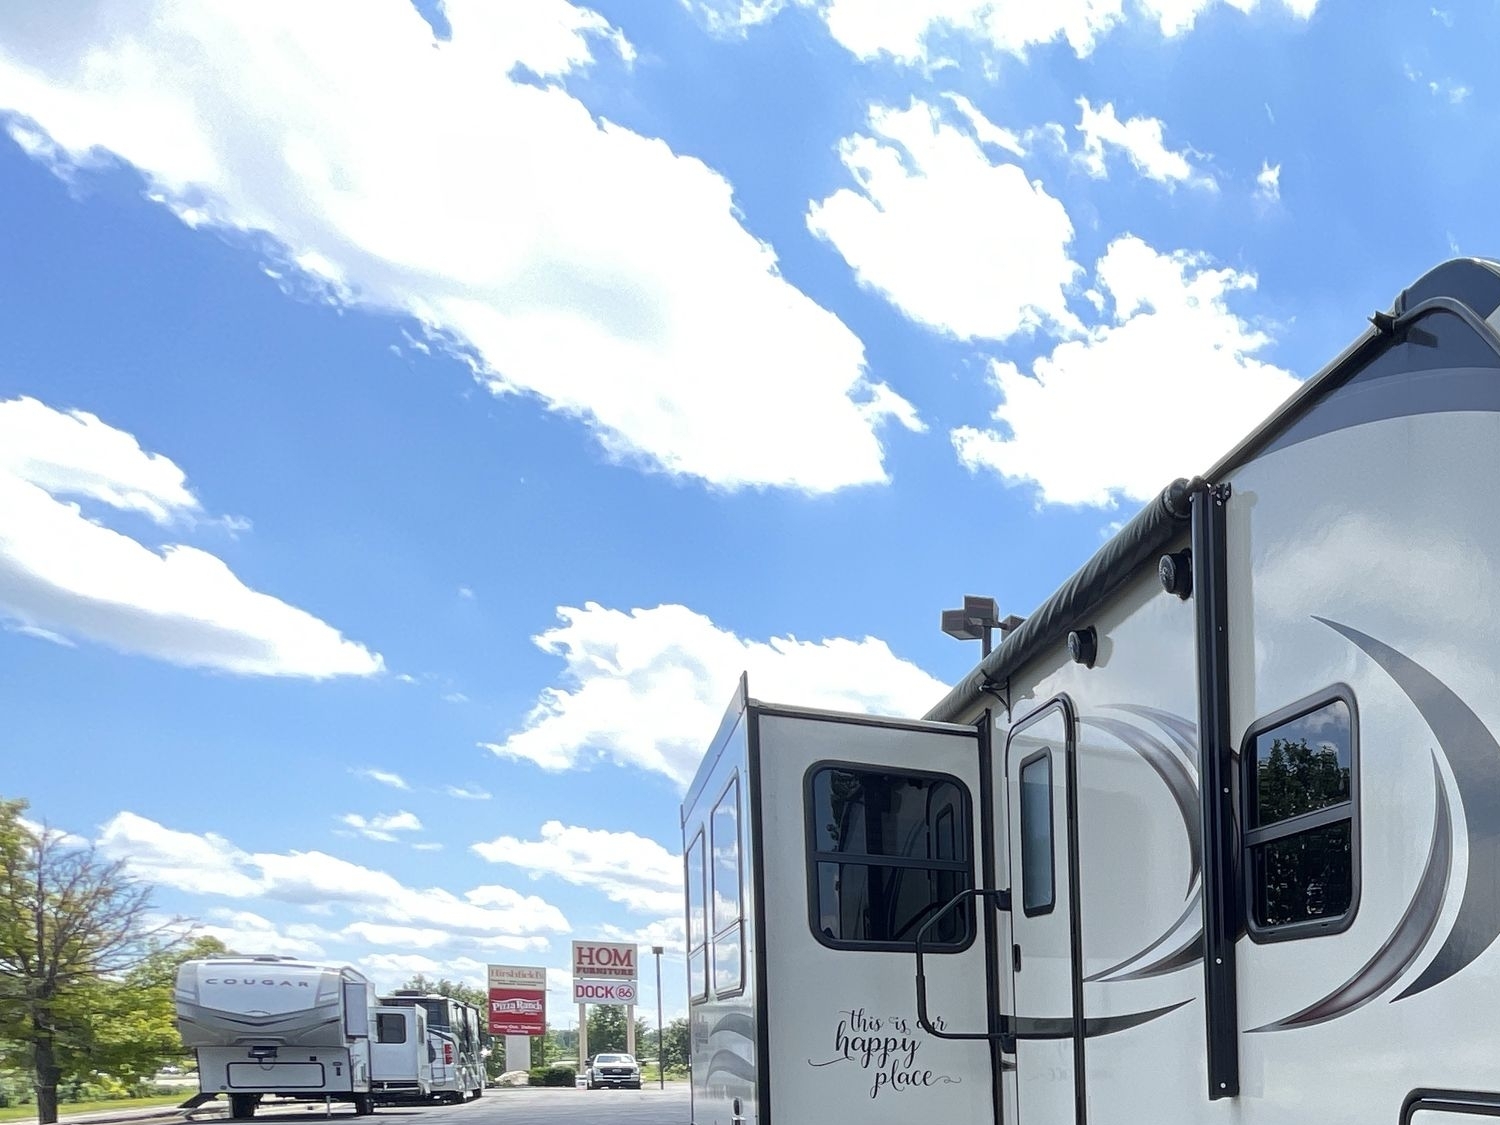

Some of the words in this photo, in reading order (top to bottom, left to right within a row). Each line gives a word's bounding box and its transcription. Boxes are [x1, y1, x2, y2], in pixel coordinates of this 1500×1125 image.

[576, 946, 634, 967] HOM
[575, 966, 634, 976] FURNITURE
[205, 978, 309, 988] COUGAR
[575, 984, 615, 999] DOCK
[618, 987, 633, 998] 86
[516, 1000, 543, 1011] Ranch
[839, 1008, 883, 1033] this
[889, 1016, 911, 1035] is
[808, 1020, 921, 1069] happy
[870, 1059, 962, 1099] place
